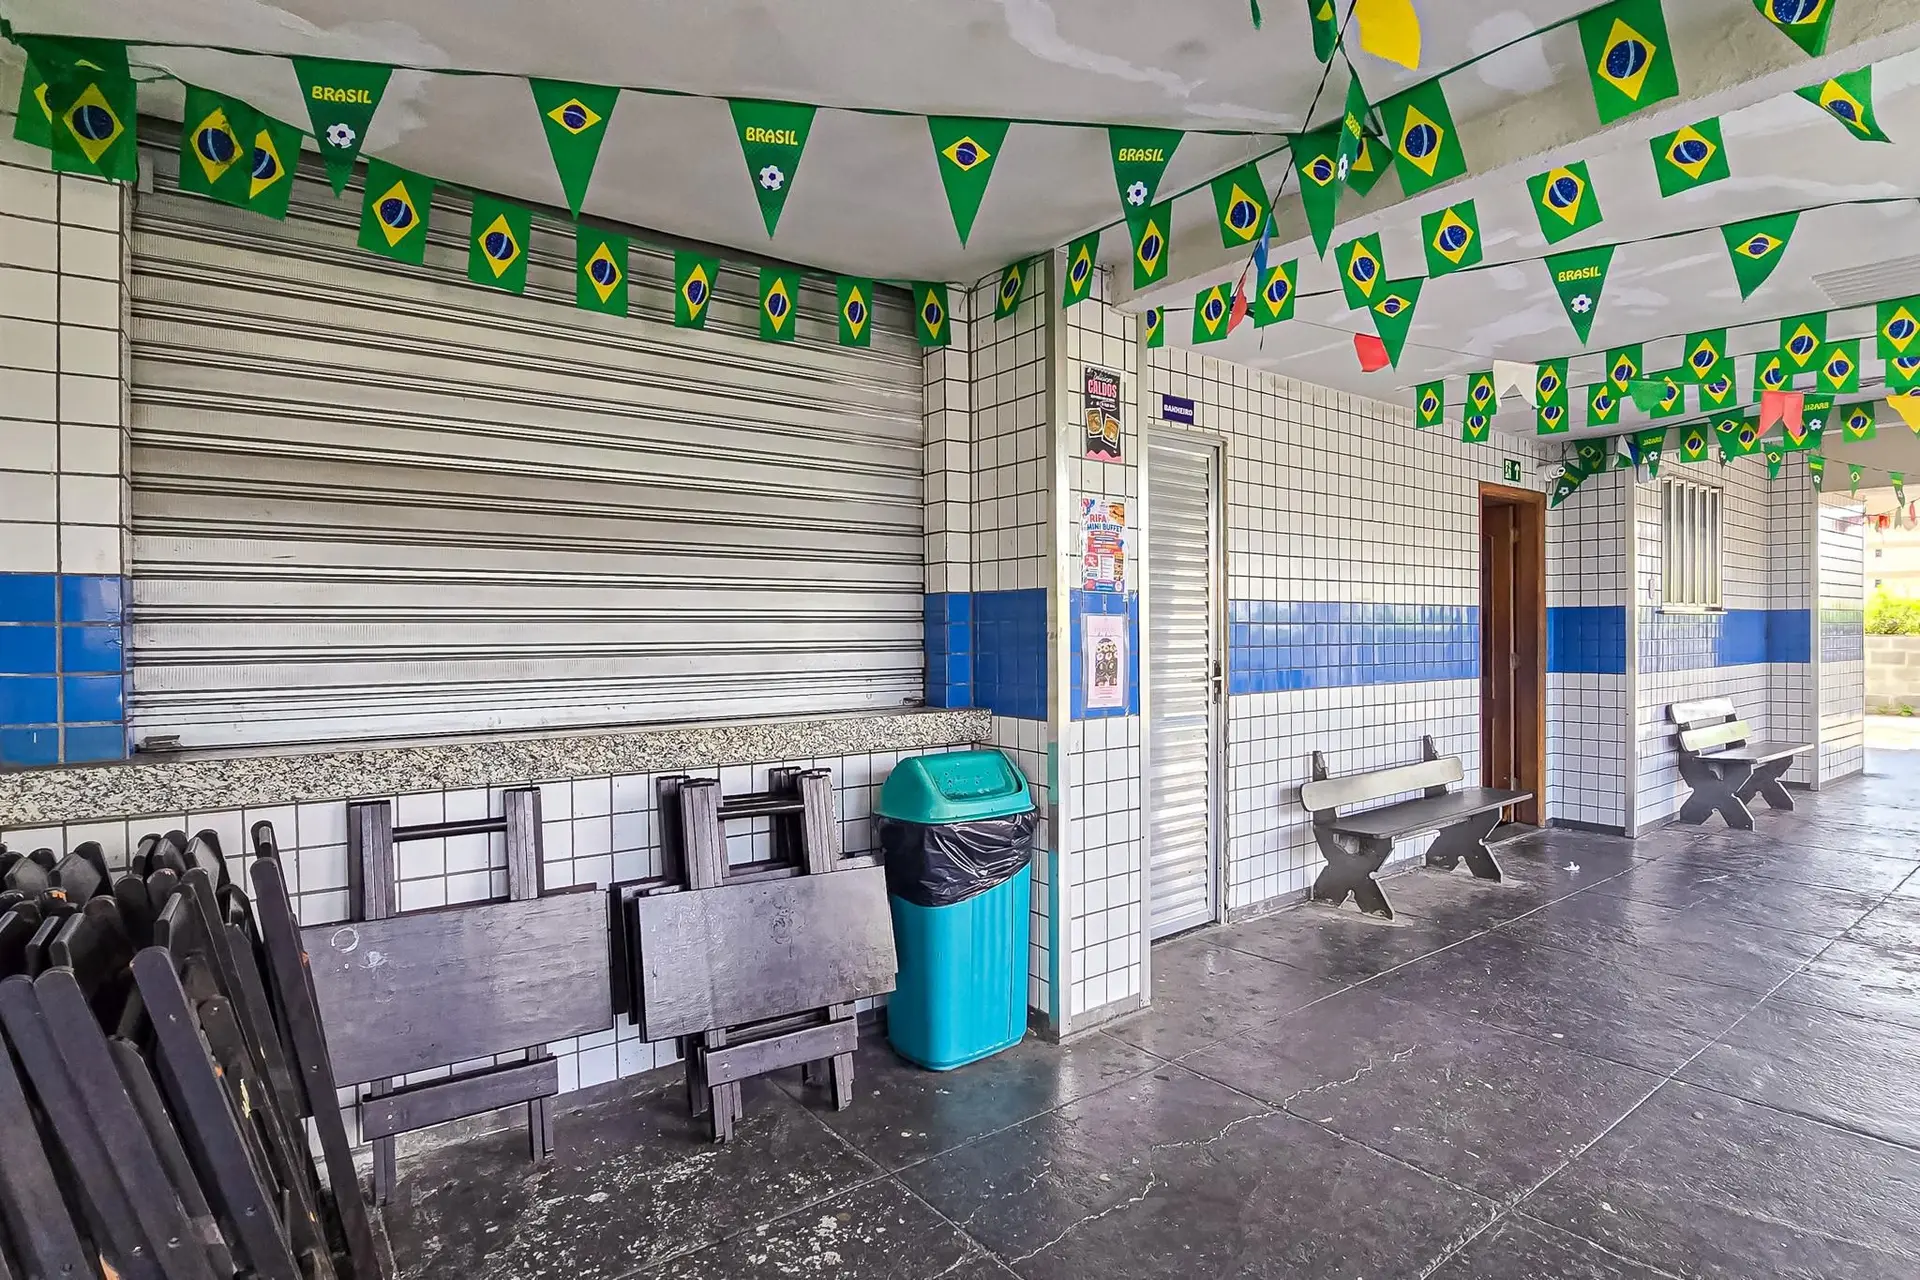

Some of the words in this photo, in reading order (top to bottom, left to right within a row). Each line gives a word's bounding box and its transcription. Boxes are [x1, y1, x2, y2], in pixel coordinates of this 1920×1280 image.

[311, 85, 372, 104] BRASIL
[745, 126, 799, 146] BRASIL
[1118, 148, 1164, 162] BRASIL
[1558, 265, 1602, 282] BRASIL
[1087, 379, 1117, 399] CALDOS
[1089, 513, 1107, 524] RIFA
[1086, 523, 1102, 531] MINI
[1102, 524, 1123, 533] BUFFET
